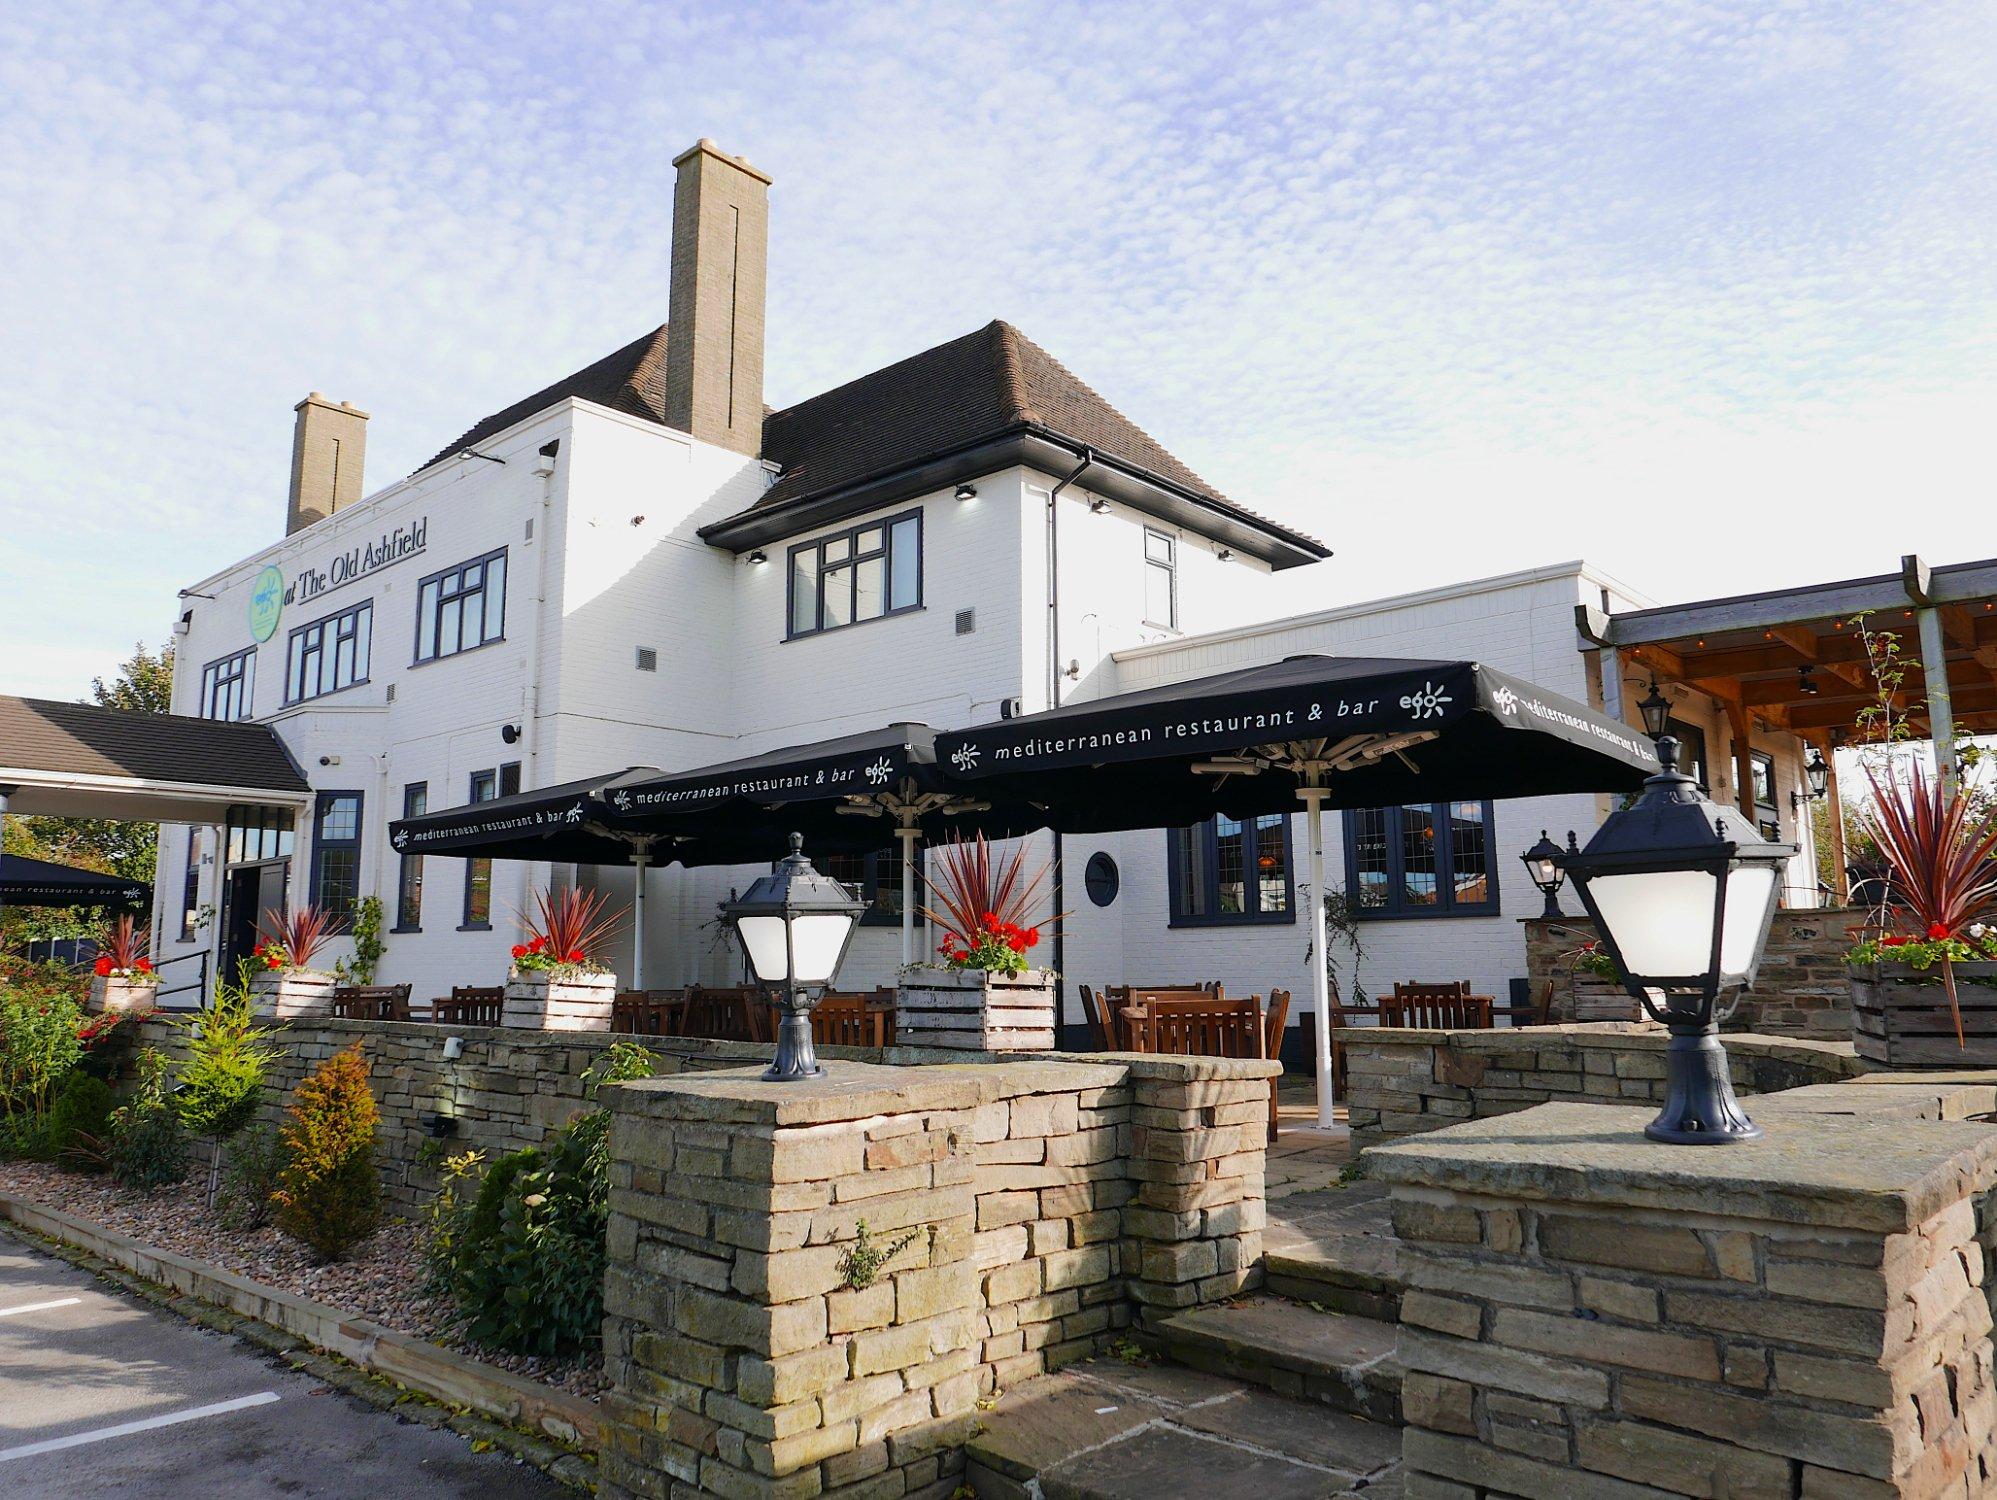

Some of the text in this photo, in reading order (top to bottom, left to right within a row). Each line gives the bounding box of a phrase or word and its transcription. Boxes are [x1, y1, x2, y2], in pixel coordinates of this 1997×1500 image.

[284, 581, 297, 606] at
[299, 567, 326, 600] The
[331, 548, 359, 585] Old
[361, 516, 428, 573] Ashfield
[995, 726, 1151, 760] mediterranean
[1164, 709, 1294, 739] restaurant
[1307, 703, 1323, 721] &
[1337, 700, 1379, 717] bar
[1591, 723, 1633, 752] restaurant
[637, 786, 729, 804] mediterranean
[733, 774, 809, 794] restaurant
[815, 770, 825, 784] &
[831, 768, 855, 782] bar
[413, 824, 480, 842] mediterranean
[482, 816, 533, 832] restaurant
[535, 812, 544, 824] &
[547, 810, 564, 823] bar
